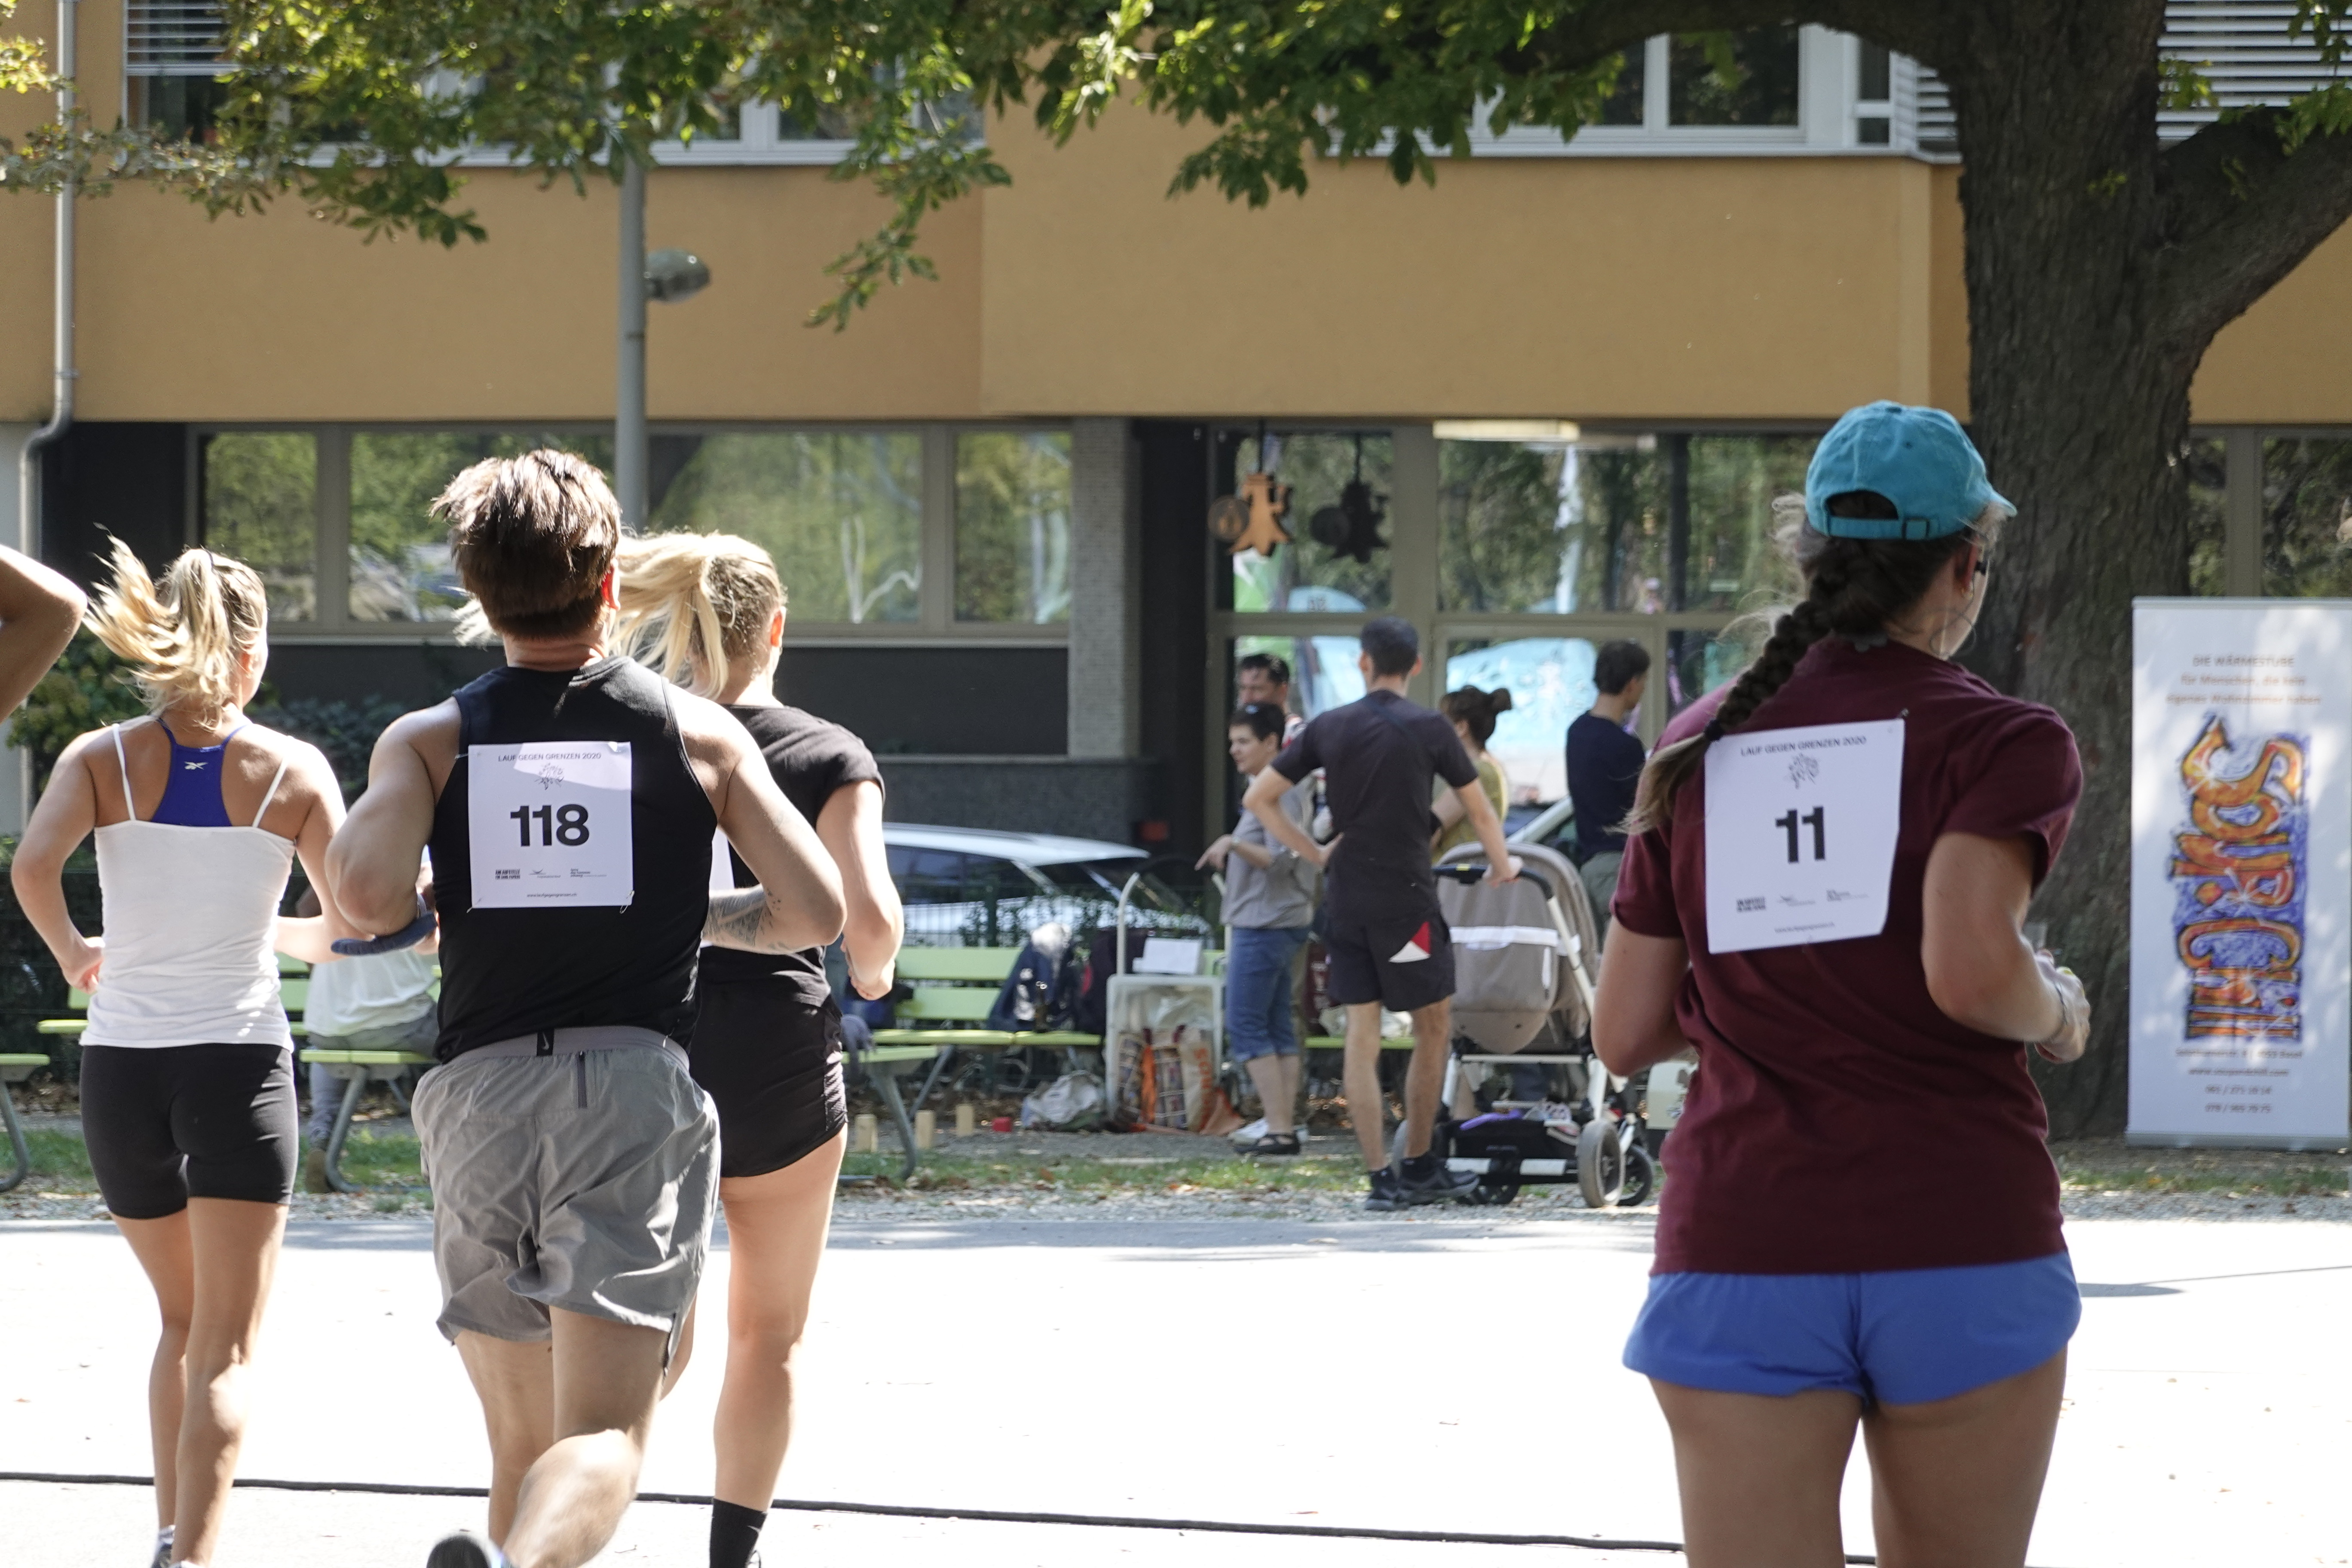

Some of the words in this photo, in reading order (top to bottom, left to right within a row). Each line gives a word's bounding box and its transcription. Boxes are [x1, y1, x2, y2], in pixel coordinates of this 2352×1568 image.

[2193, 655, 2210, 666] DIE
[1741, 746, 1761, 756] LAUF
[1764, 742, 1796, 753] GEGEN
[1797, 737, 1841, 750] GRENZEN
[1843, 735, 1867, 746] 2020
[510, 803, 589, 847] 118
[1775, 805, 1825, 864] 11
